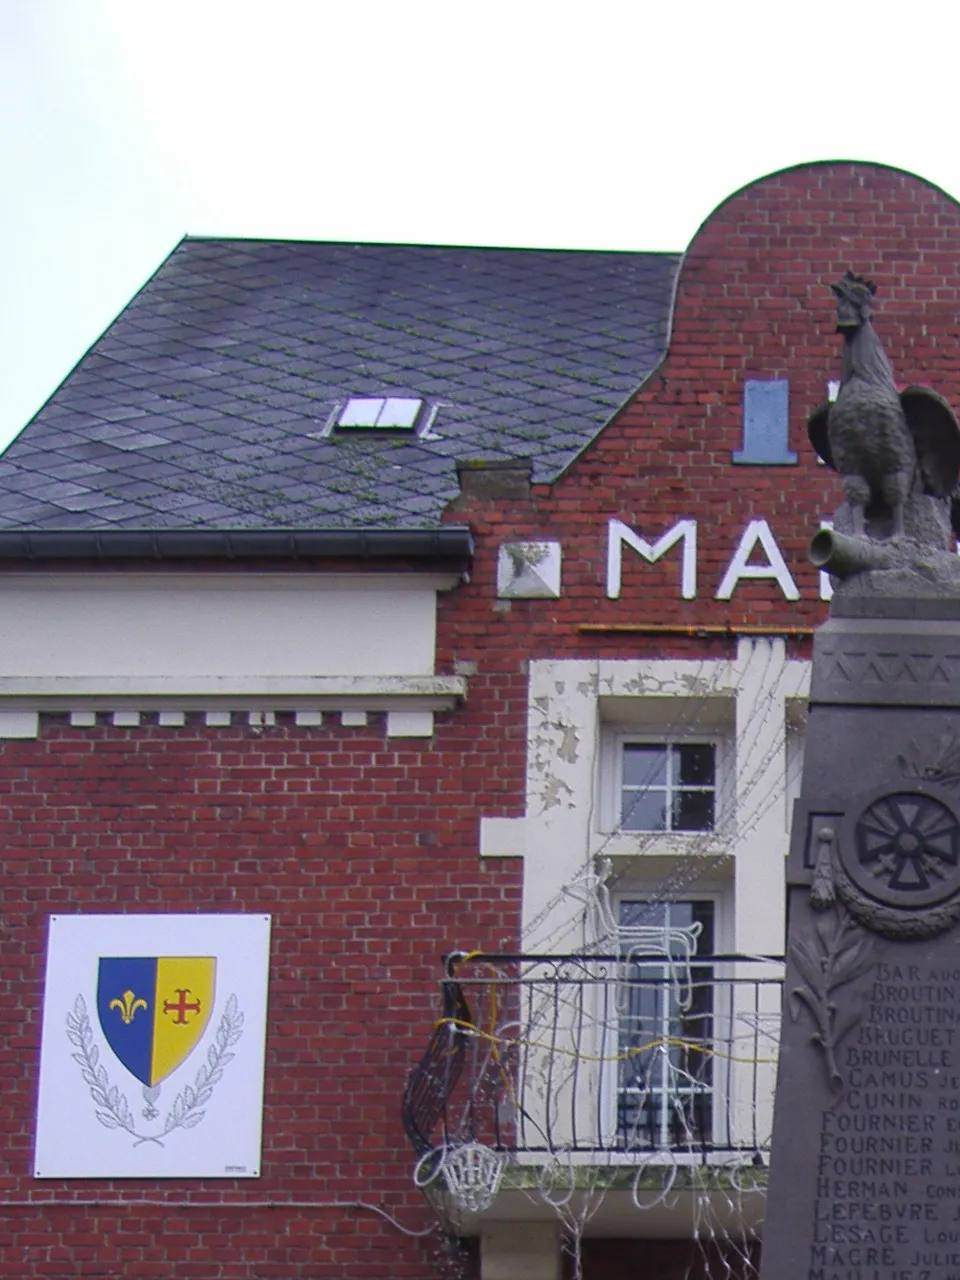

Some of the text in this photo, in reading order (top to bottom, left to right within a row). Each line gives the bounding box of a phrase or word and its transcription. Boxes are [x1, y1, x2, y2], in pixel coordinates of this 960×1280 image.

[875, 963, 921, 982] BAR
[870, 982, 956, 1004] BROUTIN
[868, 1003, 955, 1024] BROUTIN
[845, 1046, 953, 1068] BRUNELLE
[849, 1068, 929, 1089] CAMUS
[846, 1089, 923, 1111] CUNIN
[821, 1110, 936, 1133] FOURNIER
[819, 1132, 933, 1154] FOURNIER
[817, 1154, 933, 1176] FOURNIER
[816, 1177, 909, 1199] HERMAN
[812, 1223, 909, 1244] LESAGE
